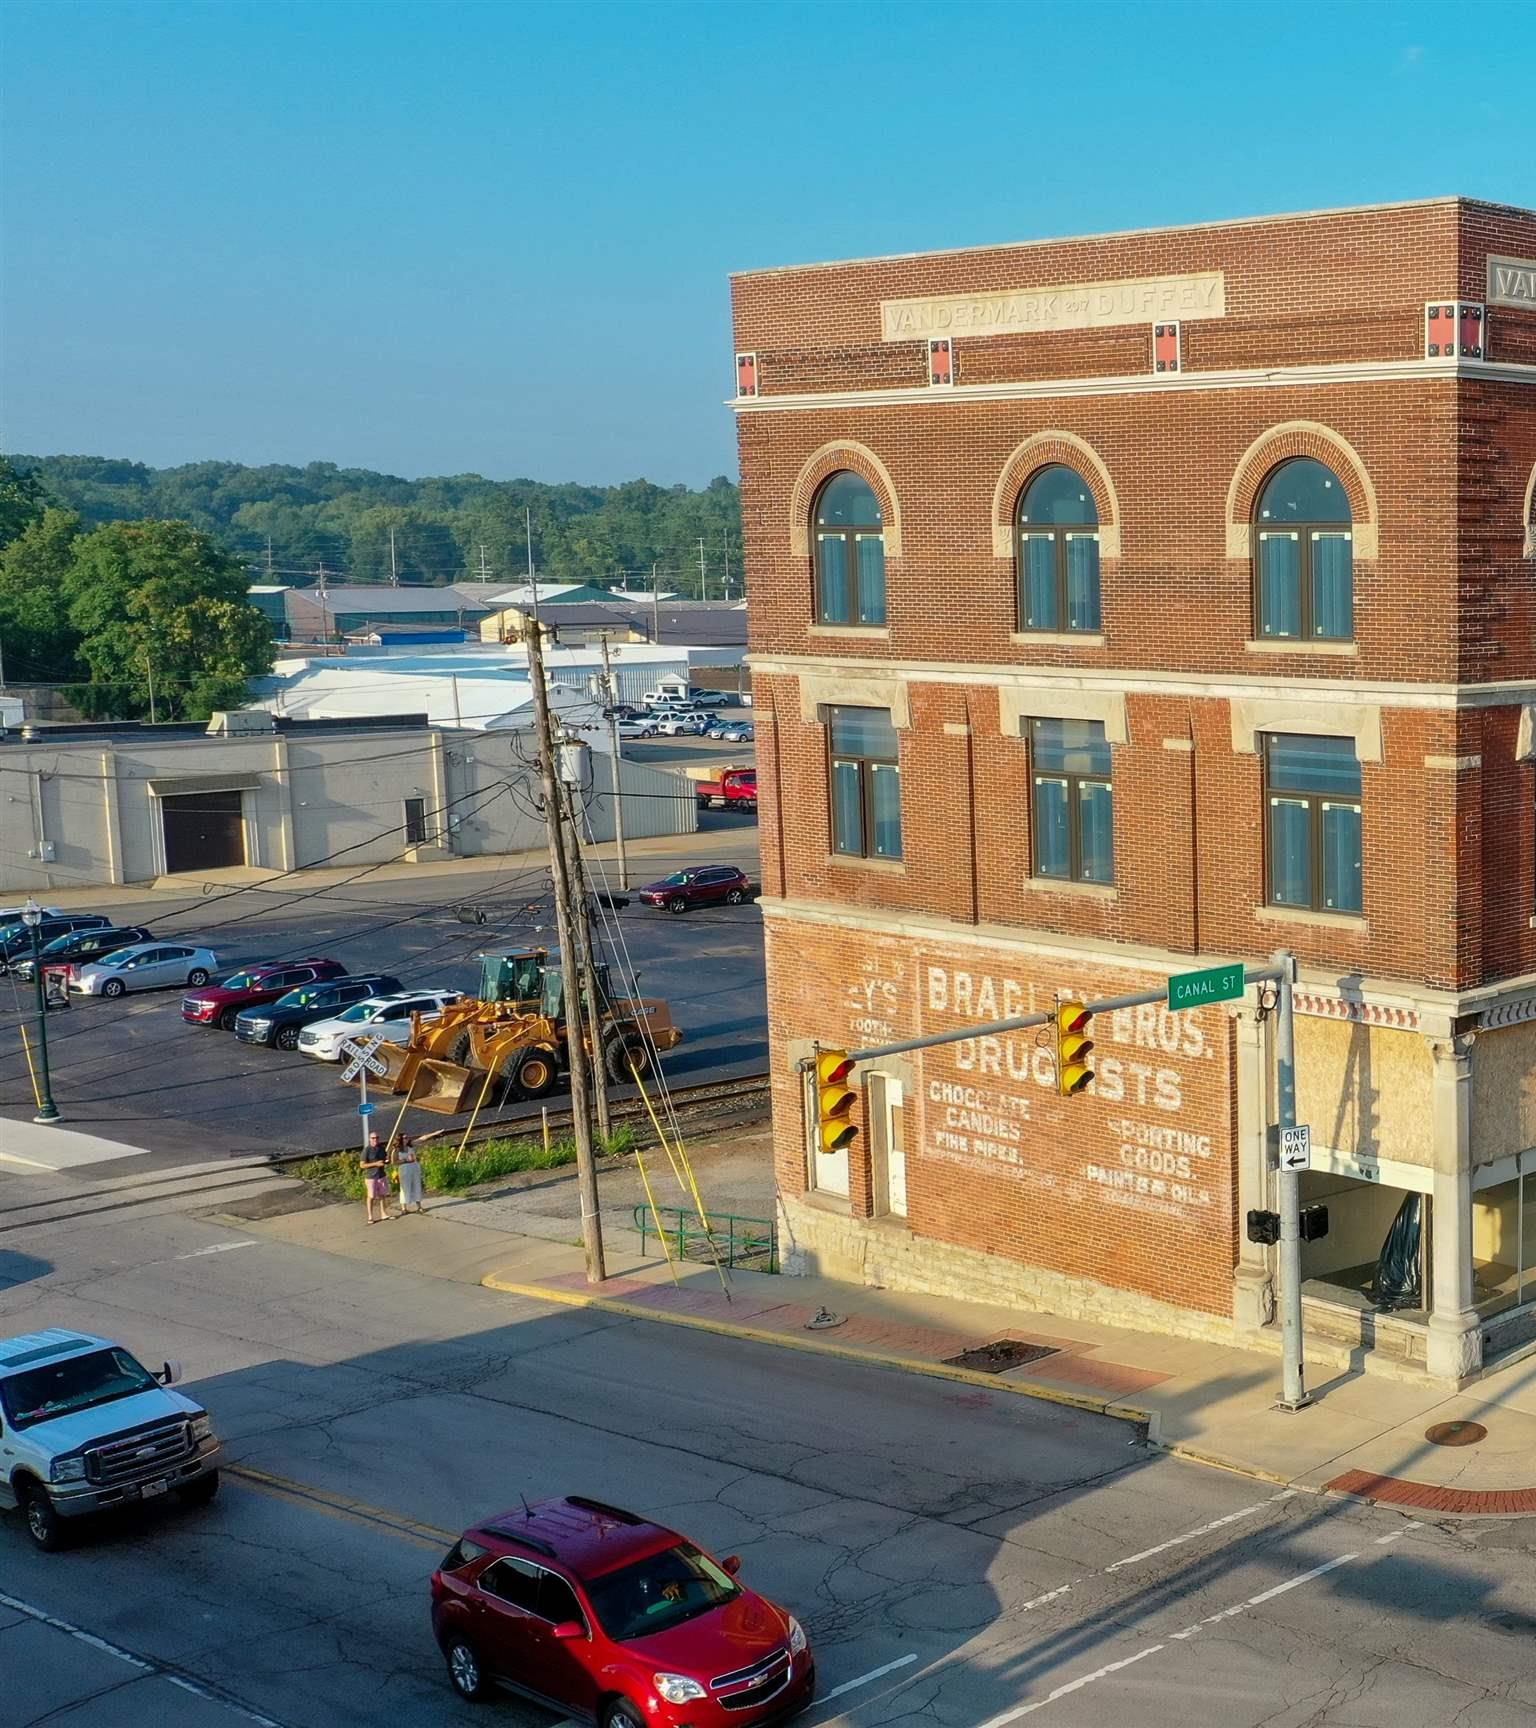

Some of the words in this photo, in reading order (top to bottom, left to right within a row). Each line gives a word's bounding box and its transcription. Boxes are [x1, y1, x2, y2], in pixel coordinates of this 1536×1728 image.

[888, 298, 1058, 331] VANDERMARK
[1065, 299, 1090, 313] 2017
[1096, 281, 1217, 316] DUFFEY
[1177, 980, 1215, 999] CANAL
[1222, 975, 1236, 990] ST
[340, 1038, 361, 1058] RAIL
[364, 1057, 385, 1075] ROAD
[343, 1033, 383, 1081] CROSSING
[953, 1036, 1183, 1112] DRUGISTS
[945, 1107, 1021, 1140] CANDIES
[1285, 1129, 1306, 1142] ONE
[1285, 1141, 1307, 1154] WAY
